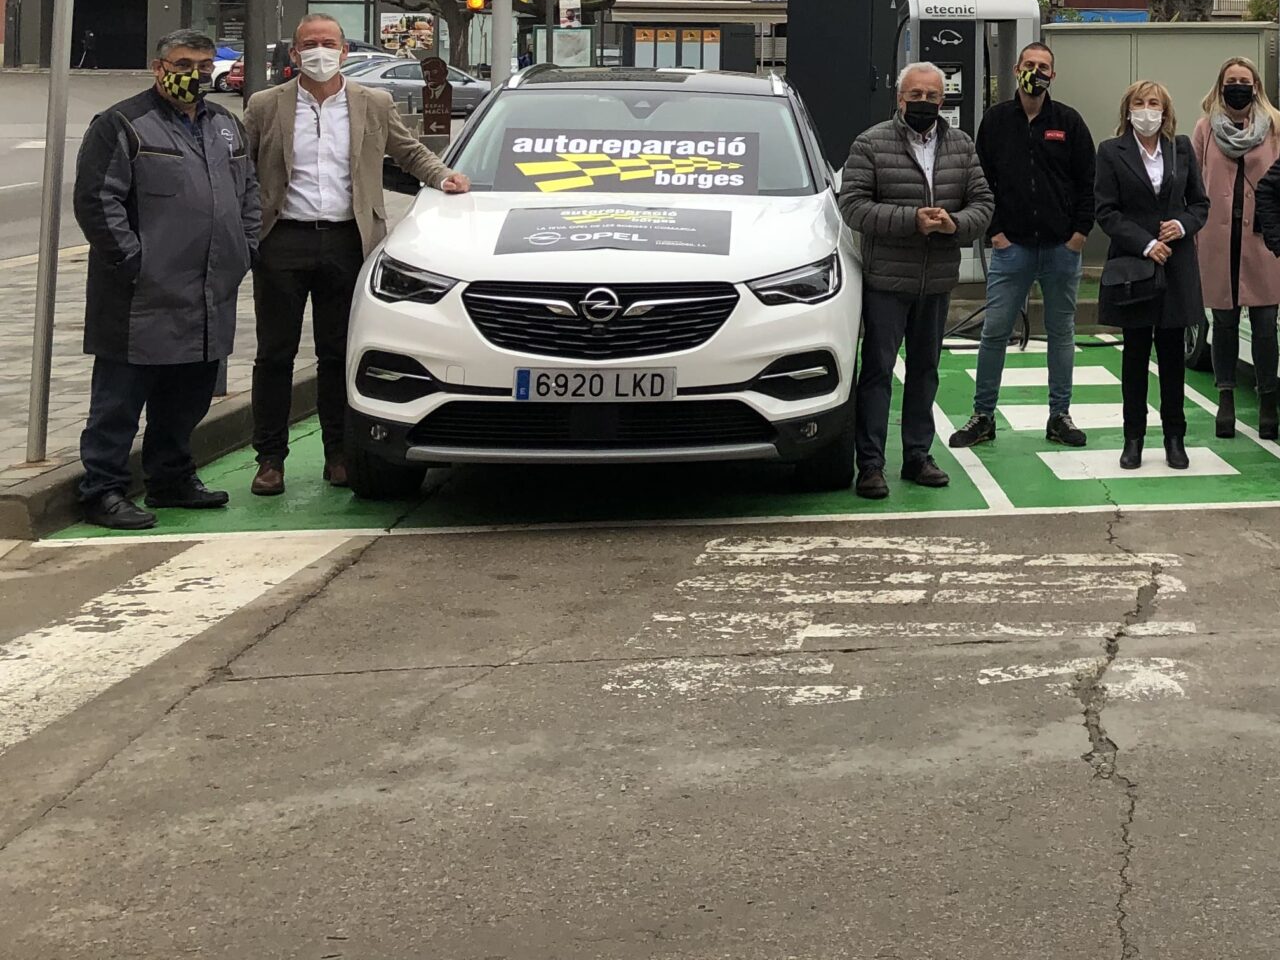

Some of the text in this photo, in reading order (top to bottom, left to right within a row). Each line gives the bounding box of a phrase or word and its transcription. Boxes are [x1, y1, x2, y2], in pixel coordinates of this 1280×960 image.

[925, 4, 975, 14] etecnic
[512, 134, 747, 158] autoreparació
[655, 171, 745, 189] borges
[560, 208, 678, 217] autoreparació
[570, 232, 649, 242] OPEL
[536, 373, 604, 398] 6920
[615, 373, 665, 397] LKD
